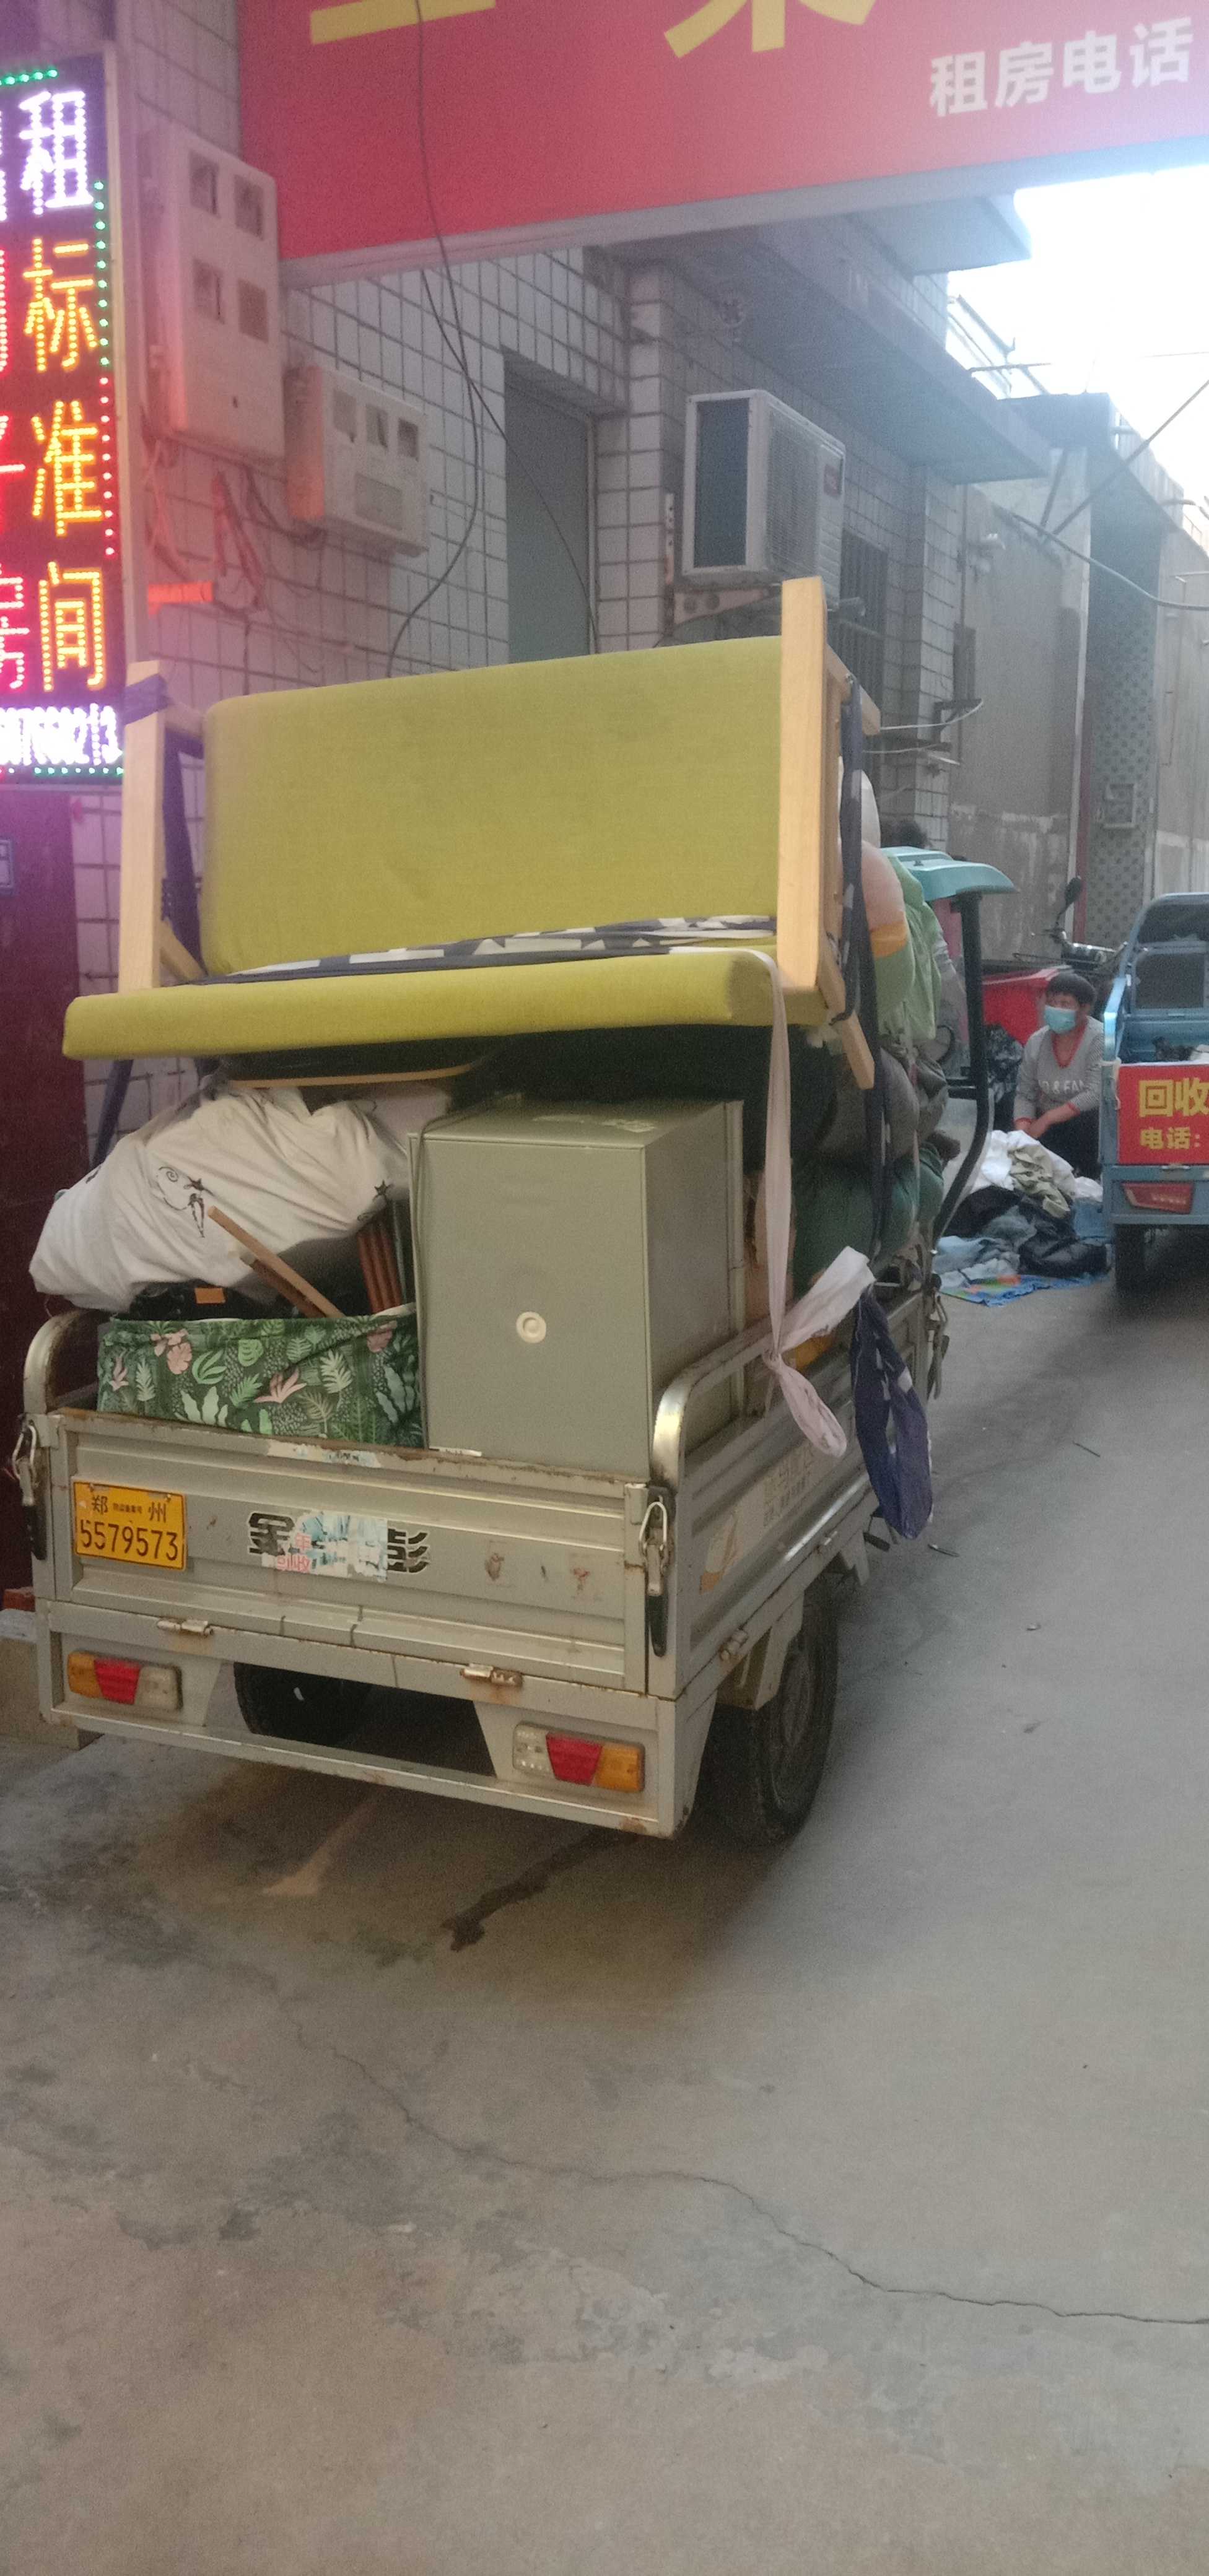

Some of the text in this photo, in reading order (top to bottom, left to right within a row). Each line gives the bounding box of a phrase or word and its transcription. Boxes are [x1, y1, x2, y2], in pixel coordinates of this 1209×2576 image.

[930, 17, 1194, 117] 租房电话
[1138, 1077, 1209, 1117] 回收
[81, 1518, 178, 1562] 5579573
